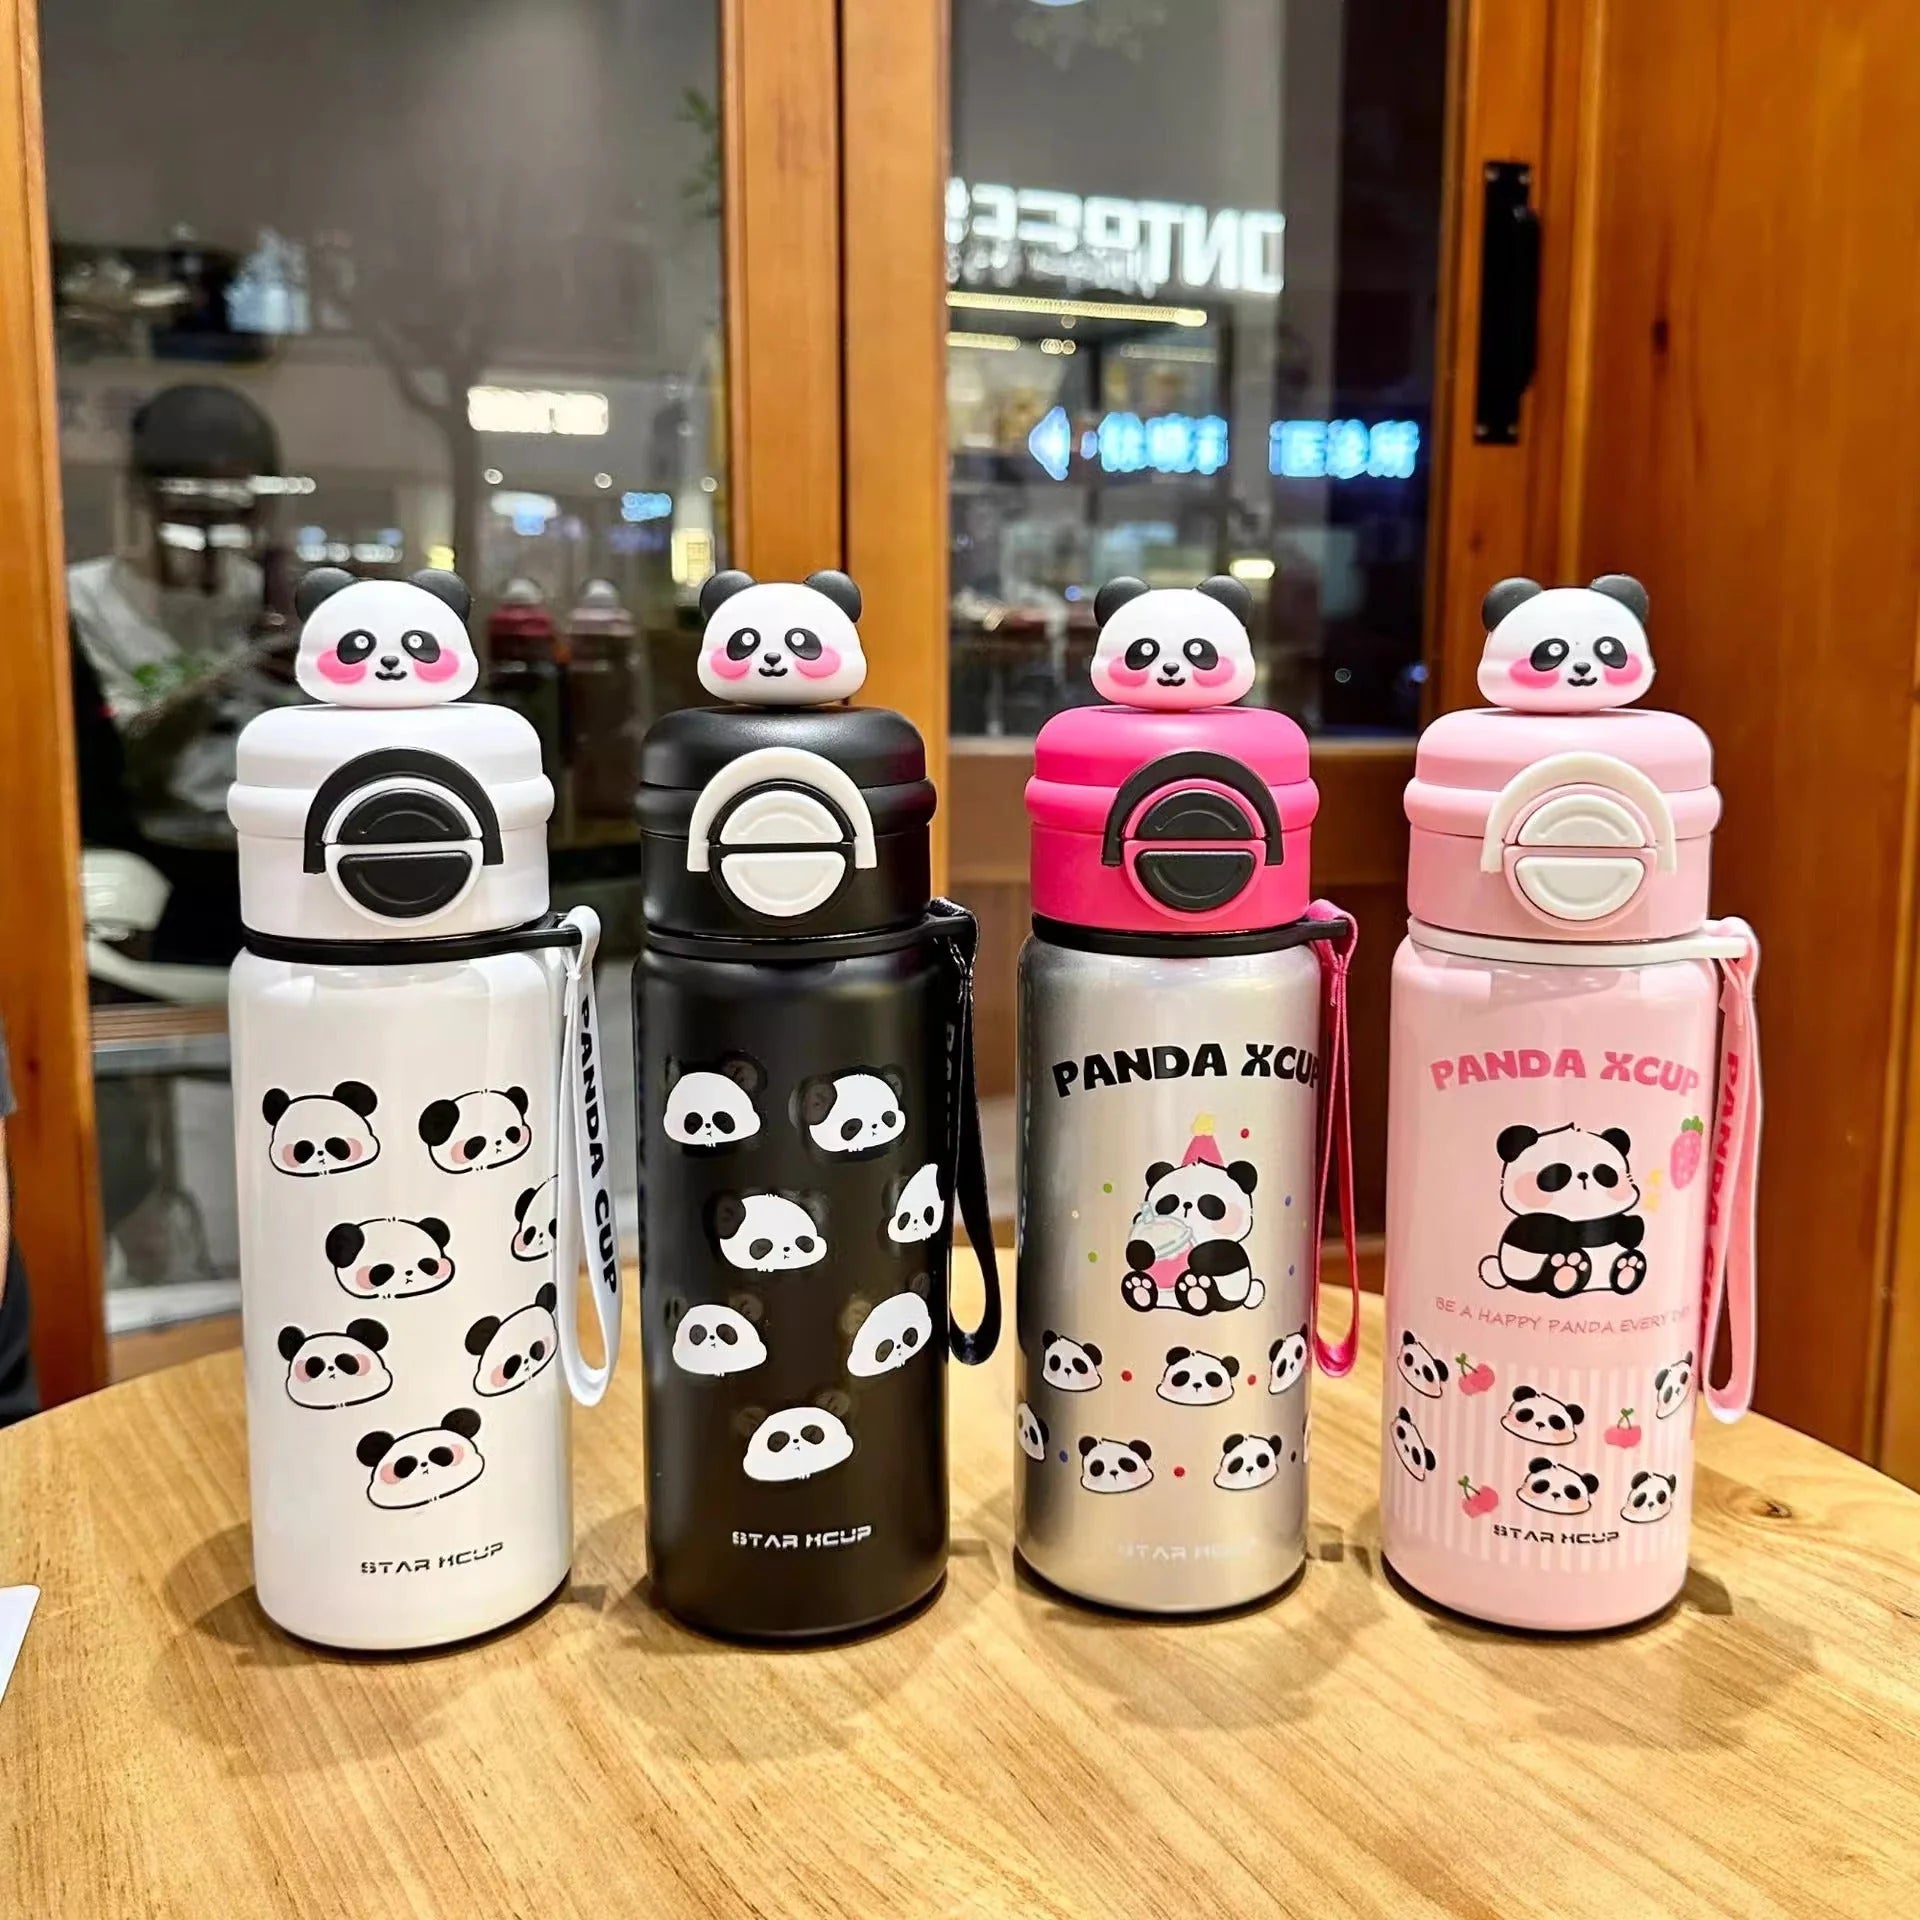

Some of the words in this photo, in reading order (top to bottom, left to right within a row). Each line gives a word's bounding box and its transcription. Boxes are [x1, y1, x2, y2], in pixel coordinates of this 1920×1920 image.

[1052, 1043, 1228, 1098] PANDA
[1241, 1043, 1320, 1088] XCUP
[1430, 1049, 1587, 1091] PANDA
[1600, 1051, 1699, 1096] XCUP
[581, 995, 605, 1179] PANDA
[594, 1188, 617, 1294] CUP
[1707, 1051, 1738, 1225] PANDA
[1436, 1297, 1456, 1312] BE
[1460, 1305, 1472, 1318] A
[1478, 1307, 1541, 1330] HAPPY
[1549, 1319, 1613, 1334] PANDA
[1620, 1311, 1668, 1332] EVERY
[731, 1531, 798, 1548] STAR
[1493, 1524, 1554, 1543] STAR
[361, 1558, 430, 1574] STAR
